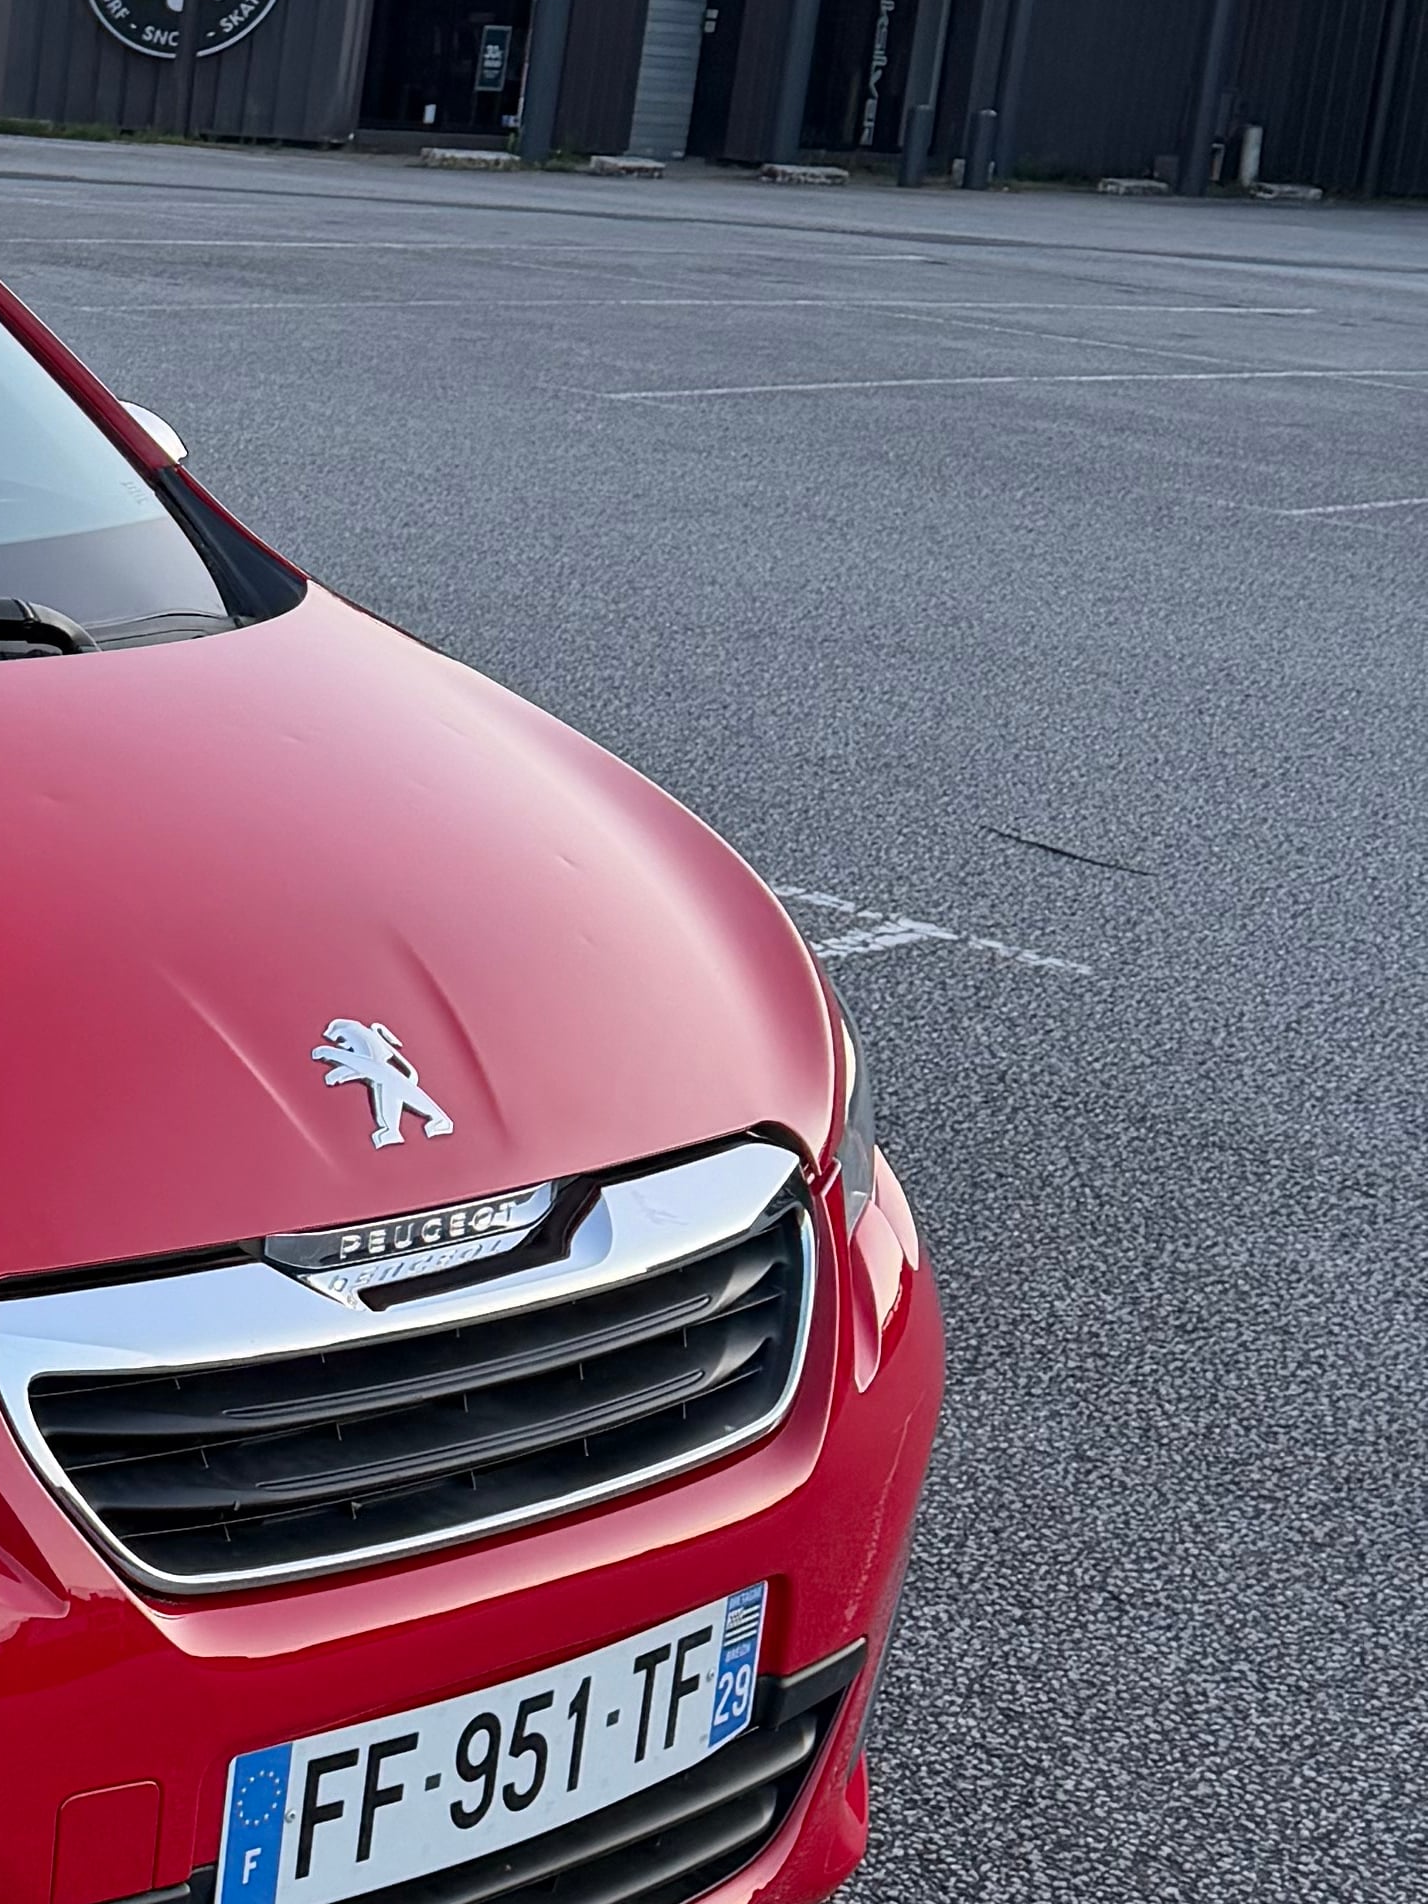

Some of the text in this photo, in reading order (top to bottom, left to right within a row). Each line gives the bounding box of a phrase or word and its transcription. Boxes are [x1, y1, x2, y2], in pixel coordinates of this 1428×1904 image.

[338, 1200, 520, 1260] PEUGEOT
[713, 1663, 752, 1727] 29
[294, 1624, 714, 1880] FF-951-TF
[242, 1847, 262, 1885] F
